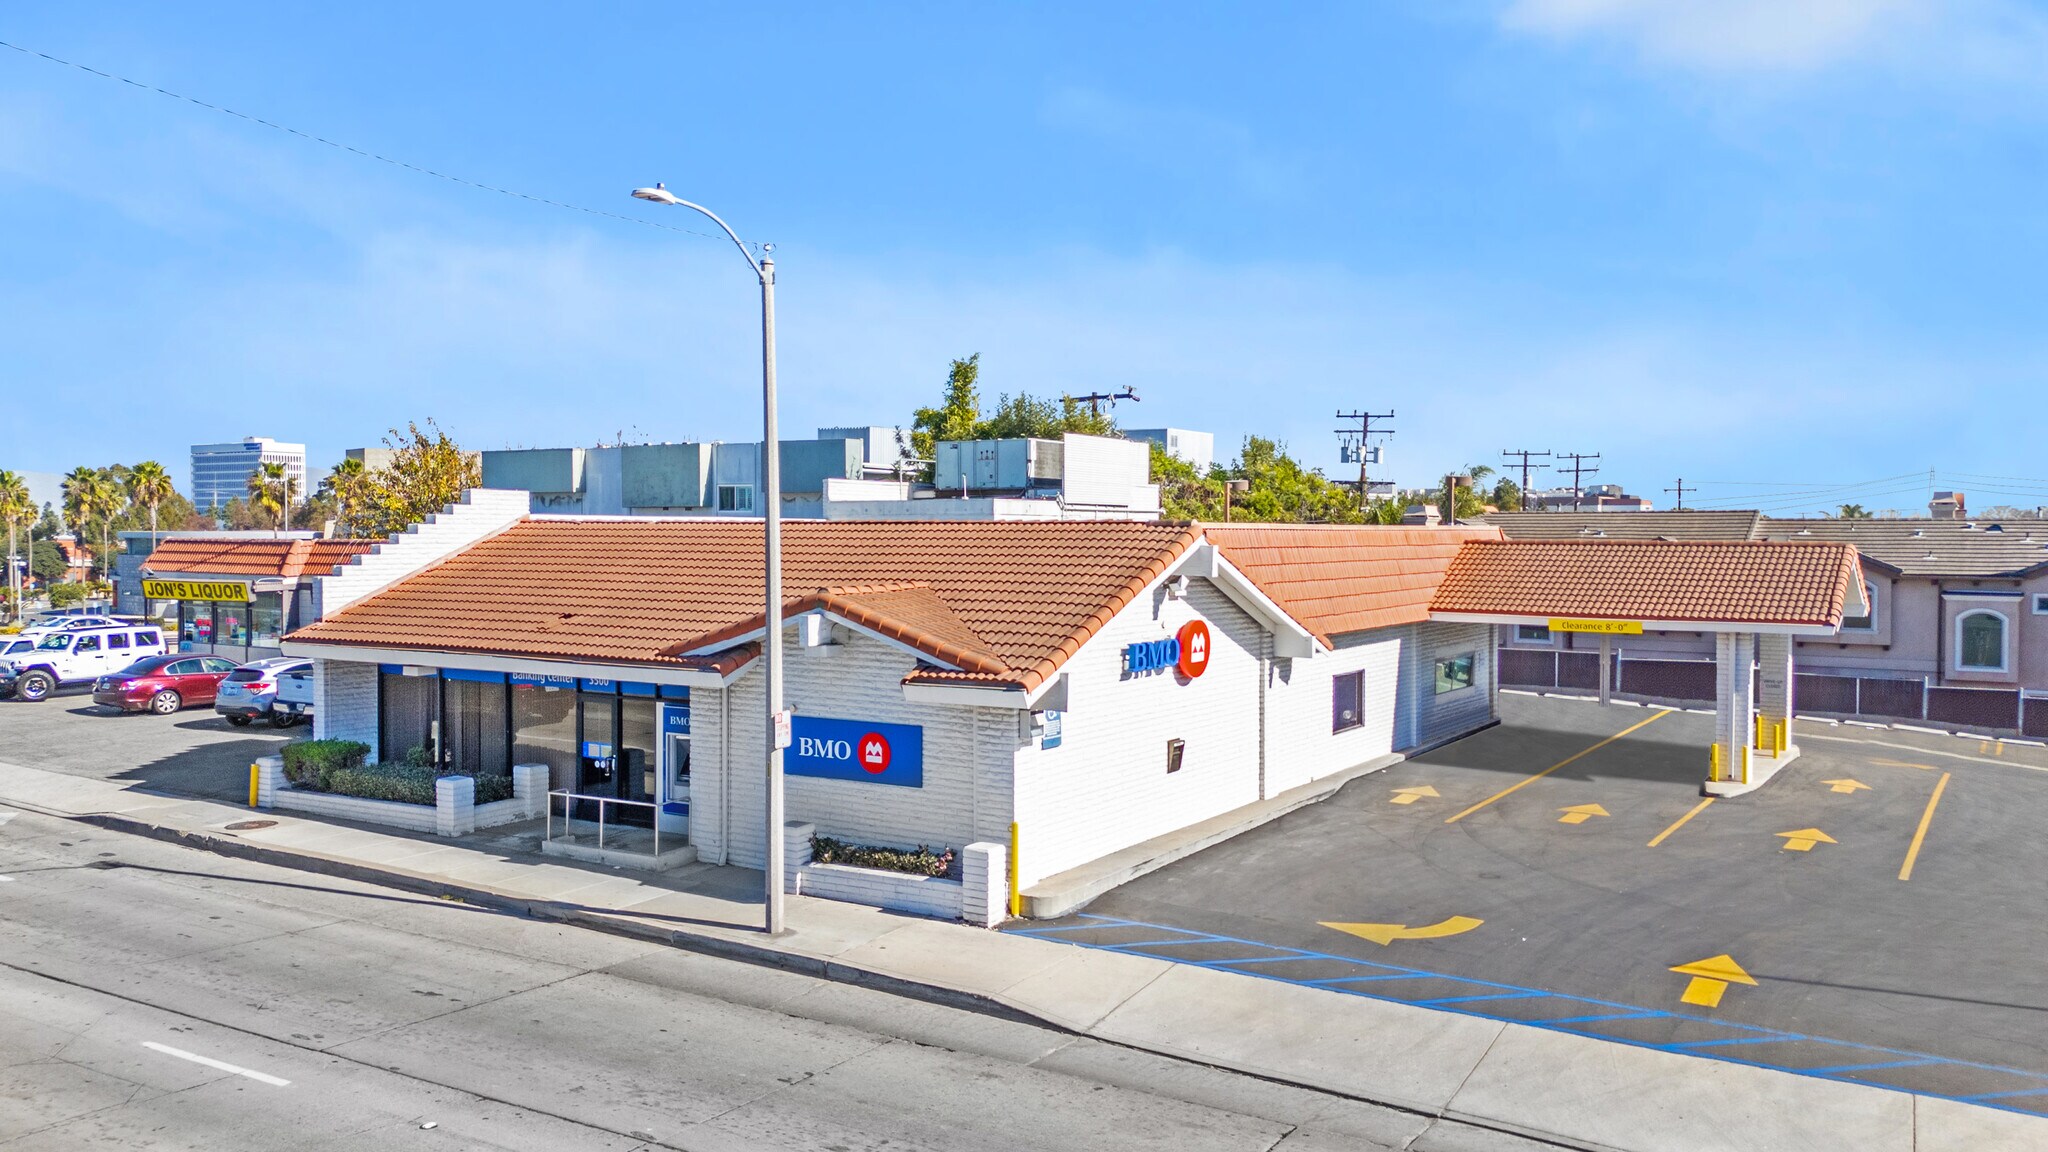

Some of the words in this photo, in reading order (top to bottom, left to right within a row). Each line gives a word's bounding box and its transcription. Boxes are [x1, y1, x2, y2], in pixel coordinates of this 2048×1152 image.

[148, 582, 187, 597] JON'S
[190, 583, 245, 599] LIQUOR
[1561, 621, 1603, 631] Clearance
[1129, 638, 1180, 672] BMO
[669, 715, 690, 726] BMO
[798, 736, 851, 760] BMO
